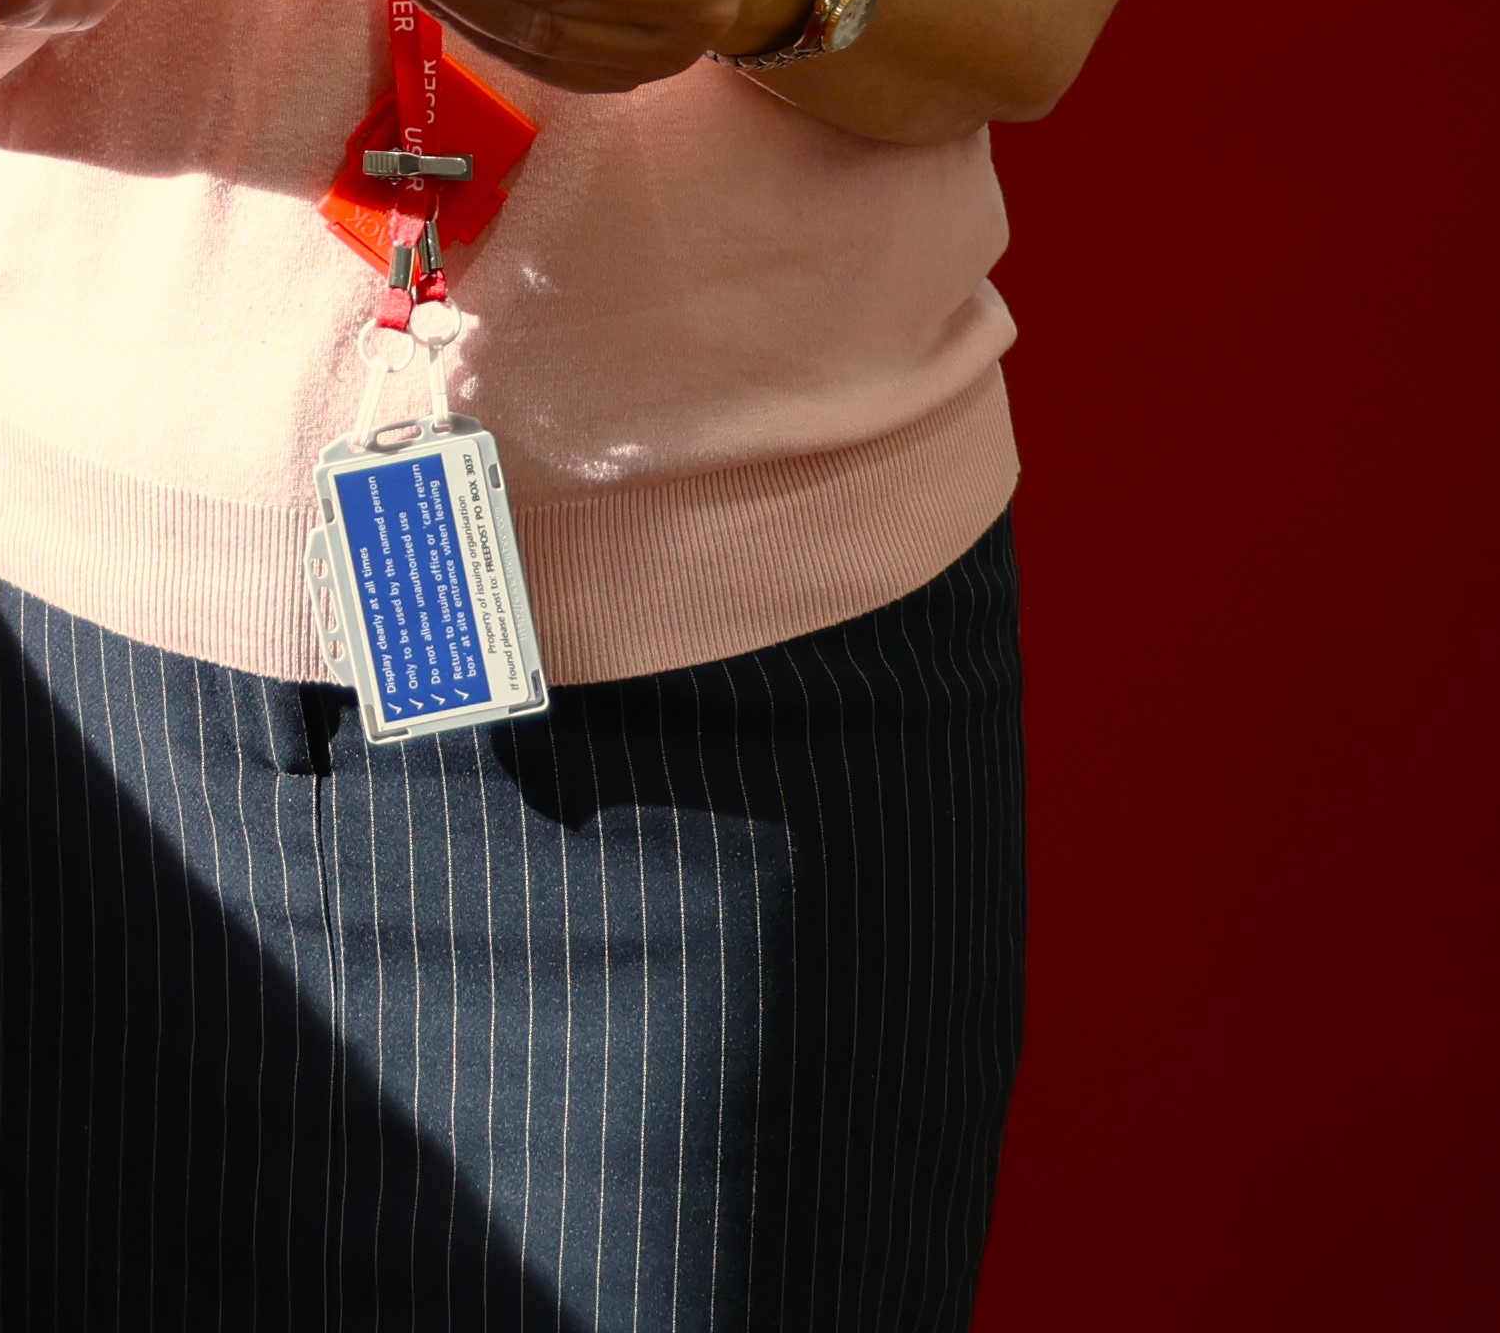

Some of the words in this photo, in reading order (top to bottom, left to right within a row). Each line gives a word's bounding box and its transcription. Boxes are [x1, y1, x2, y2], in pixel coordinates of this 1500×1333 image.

[463, 453, 476, 476] 3037
[412, 463, 426, 498] return
[468, 480, 481, 503] BOX
[368, 476, 384, 514] person
[430, 480, 445, 521] leaving
[398, 511, 410, 531] use
[458, 495, 477, 559] organisation
[473, 505, 484, 521] PO
[374, 516, 391, 555] named
[426, 534, 436, 546] or
[438, 524, 452, 556] when
[477, 524, 495, 573] FREEPOST
[359, 547, 373, 578] times
[384, 558, 396, 578] the
[400, 534, 425, 607] unauthorised
[429, 549, 443, 582] office
[364, 580, 376, 594] all
[389, 581, 401, 596] by
[446, 559, 463, 608] entrance
[471, 561, 485, 595] issuing
[490, 578, 499, 590] to:
[368, 597, 380, 610] at
[391, 598, 406, 626] used
[437, 584, 452, 623] issuing
[477, 598, 488, 609] of
[492, 592, 506, 614] post
[372, 614, 388, 650] clearly
[419, 611, 432, 641] allow
[445, 626, 455, 639] to
[456, 611, 468, 632] site
[482, 611, 497, 654] Property
[498, 616, 513, 648] please
[399, 629, 409, 644] be
[460, 635, 471, 647] at
[403, 646, 413, 660] to
[425, 644, 437, 665] not
[448, 642, 464, 680] Return
[503, 650, 517, 681] found
[381, 654, 397, 694] Display
[405, 663, 419, 690] Only
[430, 668, 441, 685] Do
